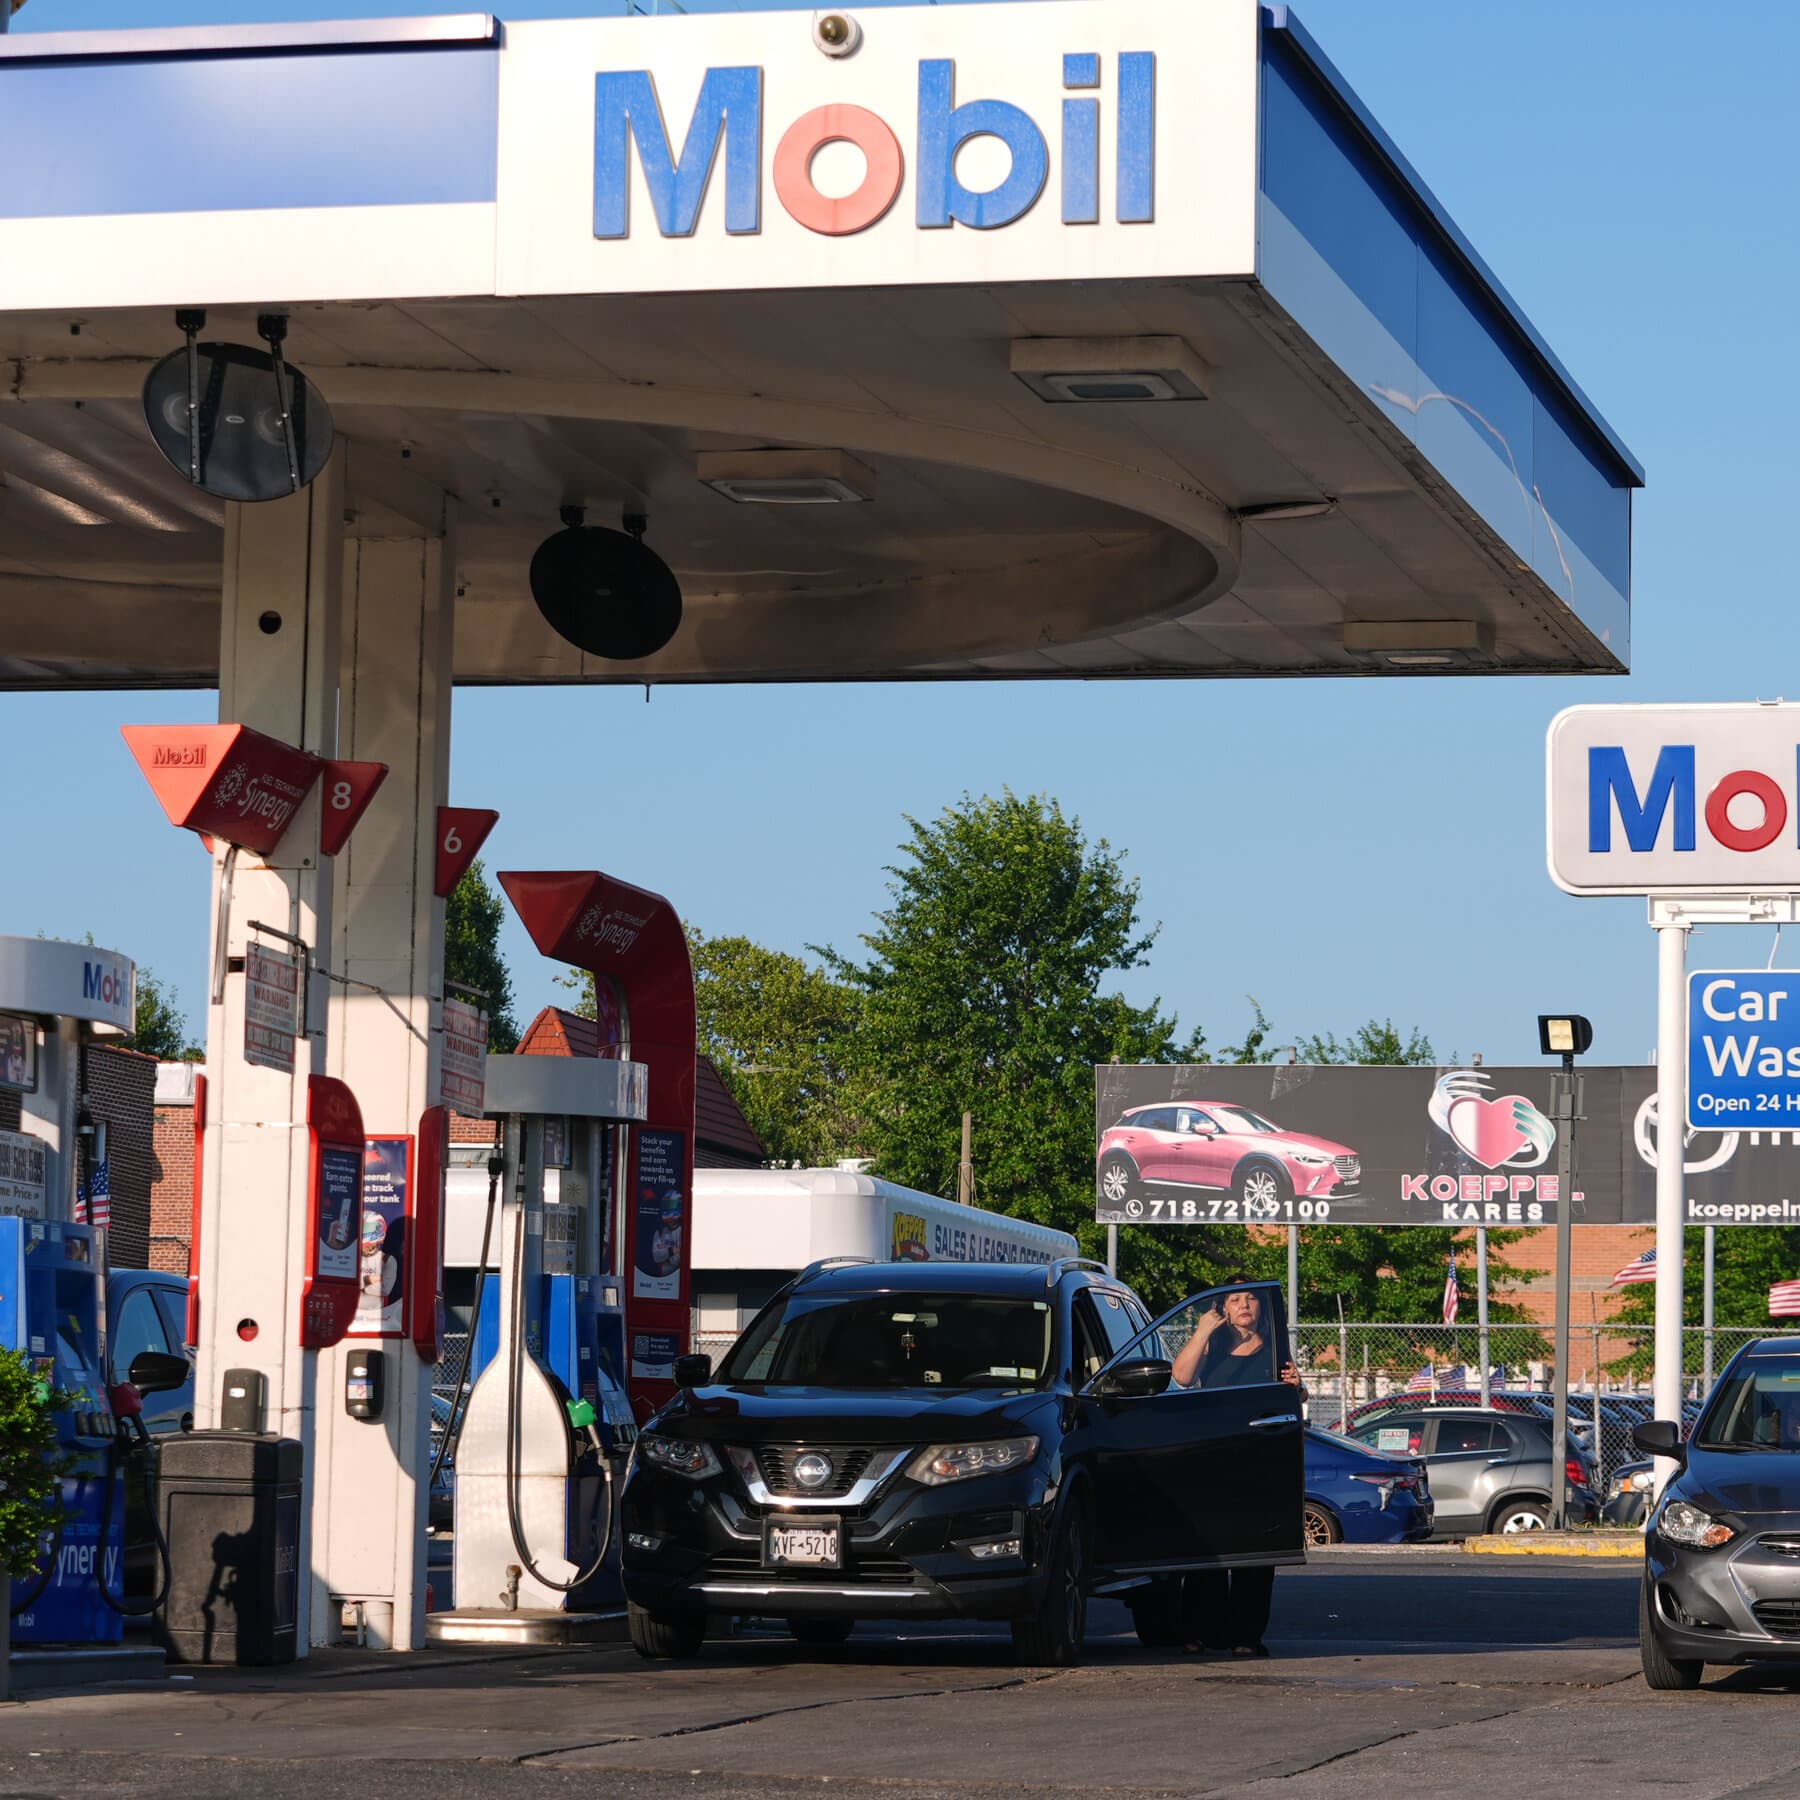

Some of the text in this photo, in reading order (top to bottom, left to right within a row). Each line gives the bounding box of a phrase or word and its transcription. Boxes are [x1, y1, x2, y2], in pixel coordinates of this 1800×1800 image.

[593, 51, 1157, 239] Mobil
[153, 747, 205, 765] Mobil
[238, 778, 295, 831] Synergy
[331, 781, 352, 810] 8
[444, 826, 462, 854] 6
[593, 913, 639, 956] Synergy
[83, 961, 129, 1009] Mobil
[254, 985, 290, 1010] WARNING
[1702, 979, 1788, 1022] Car
[446, 1035, 480, 1058] WARNING
[1697, 1093, 1750, 1116] Open
[1756, 1093, 1781, 1111] 24
[641, 1136, 657, 1144] Stack
[641, 1145, 666, 1154] benefits
[641, 1155, 652, 1163] and
[326, 1171, 353, 1183] Earn extra
[640, 1175, 676, 1186] every fill-up
[1401, 1174, 1585, 1201] KOEPPE
[14, 1185, 32, 1200] Price
[371, 1184, 394, 1192] track
[380, 1194, 400, 1203] tank
[4, 1204, 39, 1218] or Credit
[1149, 1199, 1330, 1217] 718.721.9100
[1442, 1202, 1543, 1220] KARES
[893, 1213, 927, 1257] KOEPPEL
[934, 1224, 966, 1260] SALES
[969, 1233, 977, 1260] &
[774, 1536, 836, 1556] KVF 5218
